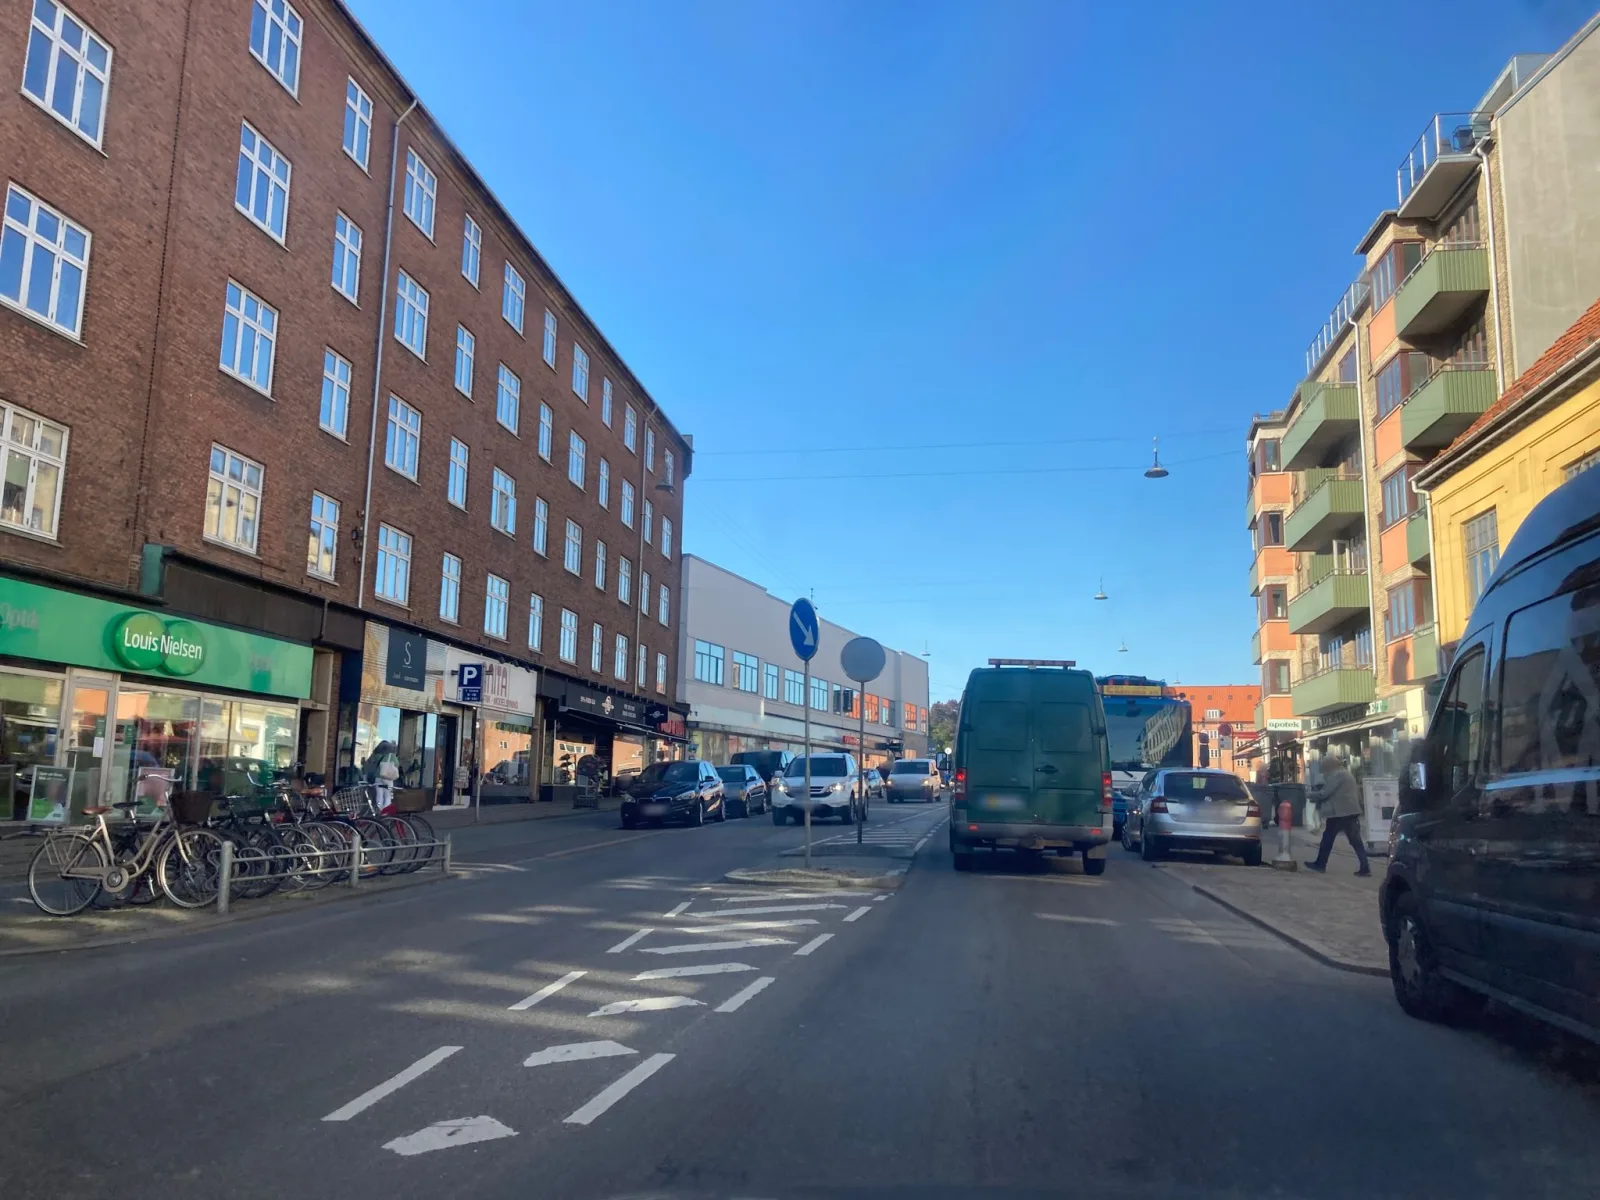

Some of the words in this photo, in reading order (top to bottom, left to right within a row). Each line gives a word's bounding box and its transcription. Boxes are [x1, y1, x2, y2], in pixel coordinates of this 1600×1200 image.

[124, 627, 159, 652] Louis
[160, 634, 203, 660] Nielsen
[463, 666, 478, 685] P
[1269, 721, 1300, 729] apotek
